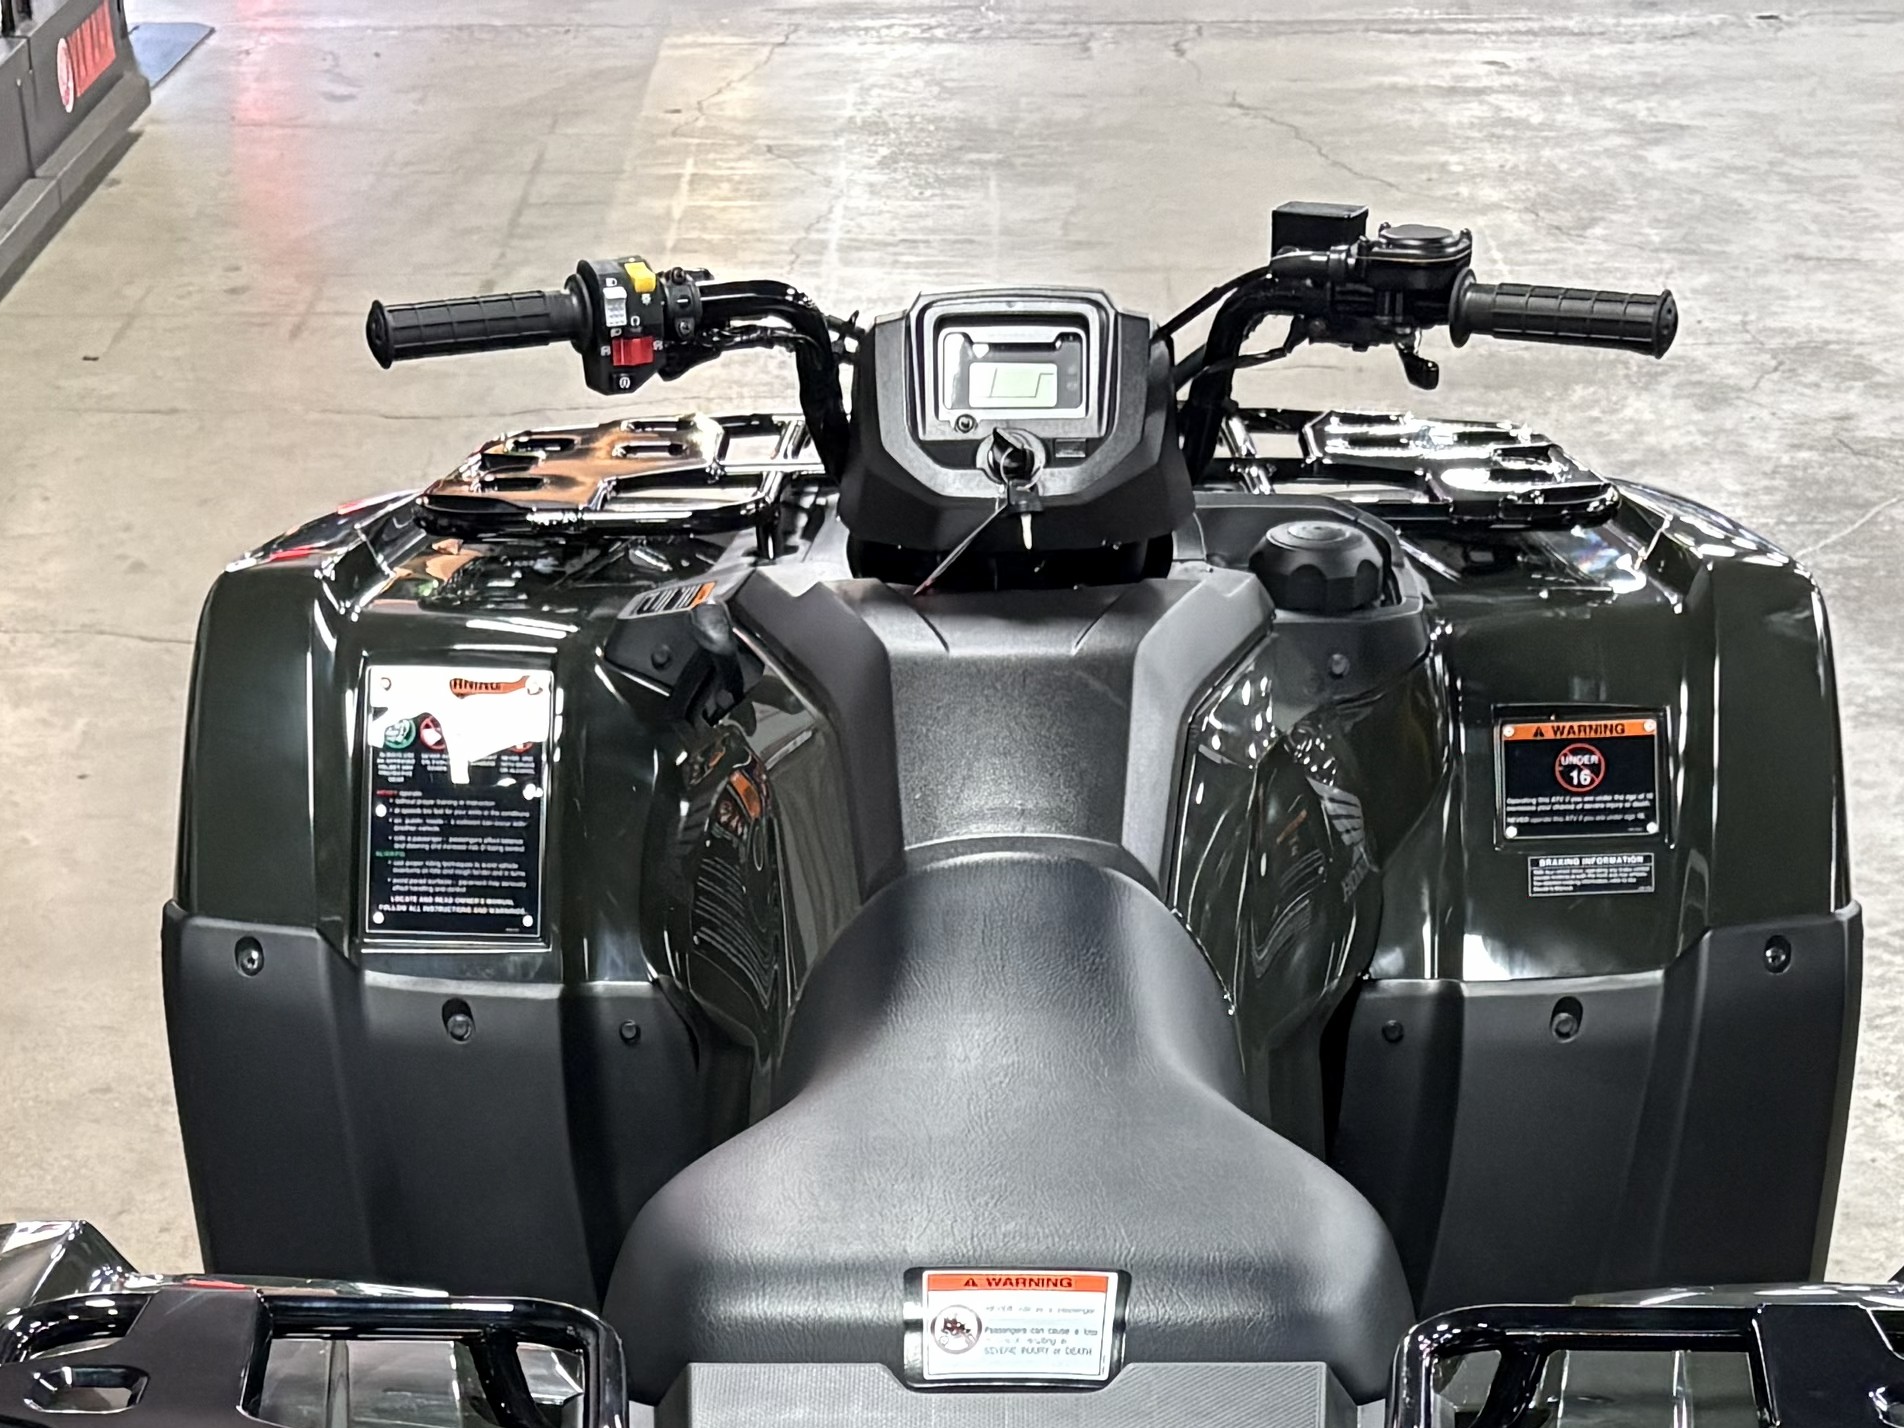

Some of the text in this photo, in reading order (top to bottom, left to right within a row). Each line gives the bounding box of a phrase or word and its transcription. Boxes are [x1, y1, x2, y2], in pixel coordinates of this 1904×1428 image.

[1551, 723, 1625, 736] WARNING
[1560, 755, 1599, 766] UNDER
[1570, 769, 1592, 785] 16
[986, 1277, 1073, 1288] WARNING
